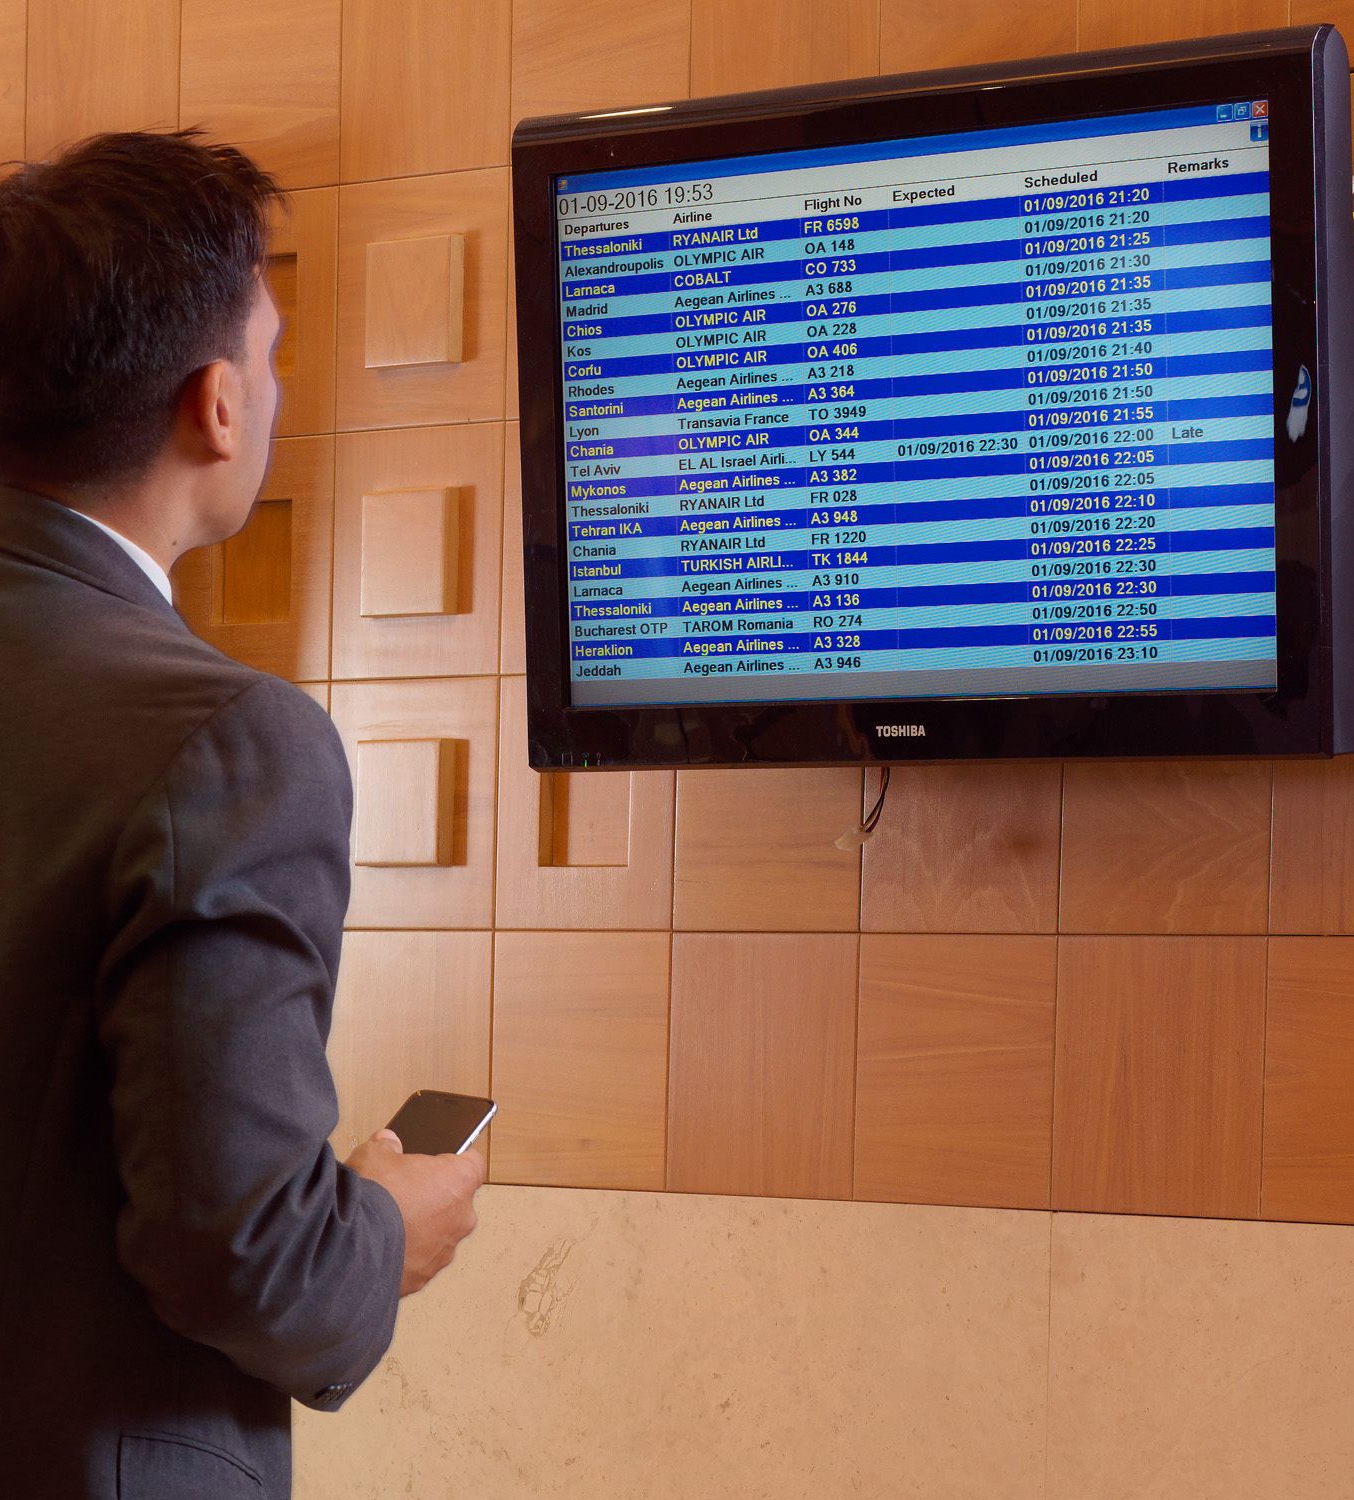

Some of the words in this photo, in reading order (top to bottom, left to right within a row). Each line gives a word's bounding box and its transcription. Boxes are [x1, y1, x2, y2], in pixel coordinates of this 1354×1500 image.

[557, 189, 658, 217] 01-09-2016
[665, 183, 713, 205] 19:53
[564, 218, 629, 238] Departures
[672, 210, 712, 225] Airline
[804, 197, 840, 214] Flight
[844, 194, 862, 208] No
[893, 185, 955, 205] Expected
[1024, 170, 1098, 190] Scheduled
[1167, 157, 1229, 175] Remarks
[564, 239, 642, 258] Thessaloniki
[673, 230, 734, 247] RYANAIR
[738, 227, 758, 241] Ltd
[804, 221, 823, 234] FR
[826, 217, 859, 232] 6598
[1024, 193, 1104, 213] 01/09/2016
[1109, 188, 1149, 204] 21:20
[564, 257, 663, 280] Alexandroupolis
[674, 250, 736, 267] OLYMPIC
[740, 248, 764, 261] AIR
[804, 242, 826, 255] OA
[831, 239, 855, 252] 148
[1024, 215, 1104, 234] 01/09/2016
[1109, 210, 1149, 226] 21:20
[565, 282, 615, 298] Larnaca
[674, 271, 731, 288] COBALT
[805, 262, 827, 276] CO
[832, 260, 856, 273] 733
[1025, 237, 1105, 256] 01/09/2016
[1109, 232, 1150, 248] 21:25
[569, 425, 599, 440] Lyon
[678, 415, 741, 430] Transavia
[744, 411, 789, 426] France
[808, 409, 828, 421] TO
[833, 406, 866, 420] 3949
[1028, 389, 1108, 406] 01/09/2016
[1112, 386, 1153, 401] 21:50
[570, 444, 613, 458] Chania
[678, 435, 741, 451] OLYMPIC
[745, 434, 769, 446] AIR
[809, 429, 830, 442] OA
[835, 427, 859, 440] 344
[1028, 411, 1108, 428] 01/09/2016
[1113, 408, 1153, 422] 21:55
[569, 466, 590, 478] Tel
[593, 464, 621, 476] Aviv
[679, 459, 696, 471] EL
[699, 457, 717, 470] AL
[721, 455, 756, 468] Israel
[809, 450, 827, 463] LY
[831, 449, 855, 462] 544
[897, 441, 975, 457] 01/09/2016
[979, 438, 1018, 452] 22:30
[1029, 432, 1109, 449] 01/09/2016
[1114, 430, 1153, 444] 22:00
[1172, 426, 1204, 440] Late
[571, 502, 648, 518] Thessaloniki
[680, 497, 740, 512] RYANAIR
[744, 496, 764, 508] Ltd
[810, 492, 828, 504] FR
[832, 490, 857, 503] 028
[1029, 476, 1109, 492] 01/09/2016
[1114, 473, 1154, 487] 22:05
[572, 544, 616, 558] Chania
[680, 538, 741, 552] RYANAIR
[745, 537, 765, 549] Ltd
[811, 533, 829, 546] FR
[834, 532, 866, 545] 1220
[1030, 519, 1110, 535] 01/09/2016
[1115, 517, 1155, 531] 22:20
[573, 564, 621, 577] Istanbul
[681, 558, 742, 572] TURKISH
[811, 554, 831, 566] TK
[836, 552, 868, 565] 1844
[1031, 541, 1111, 556] 01/09/2016
[1116, 539, 1156, 552] 22:25
[574, 624, 636, 637] Bucharest
[639, 623, 667, 635] OTP
[682, 620, 733, 633] TAROM
[737, 618, 793, 631] Romania
[813, 616, 833, 628] RO
[838, 615, 862, 627] 274
[1032, 606, 1112, 620] 01/09/2016
[1116, 604, 1157, 617] 22:50
[876, 725, 926, 737] TOSHIBA
